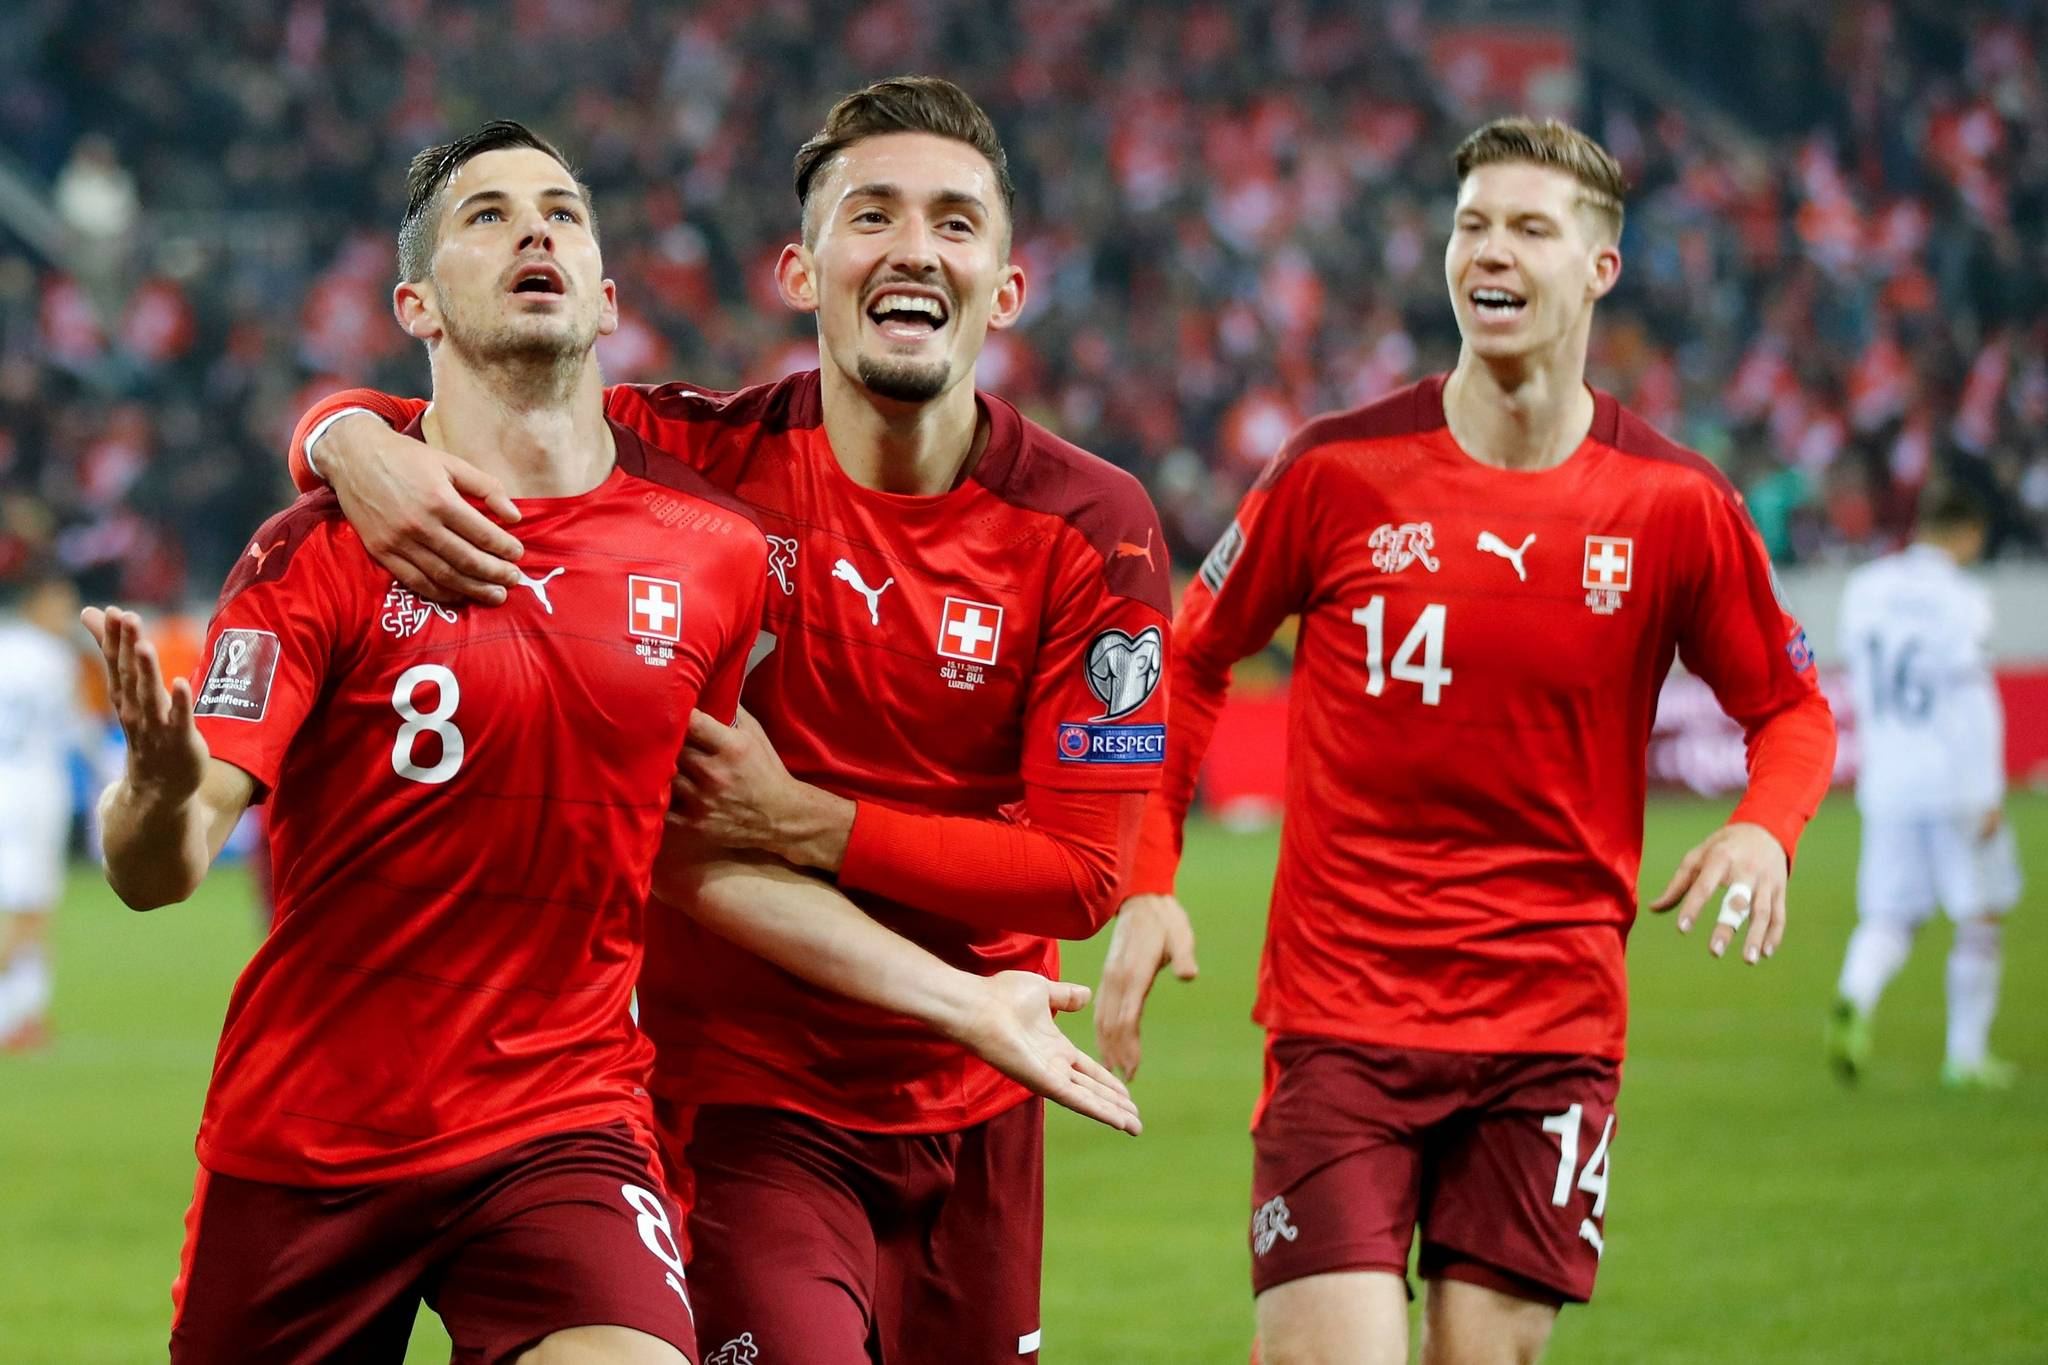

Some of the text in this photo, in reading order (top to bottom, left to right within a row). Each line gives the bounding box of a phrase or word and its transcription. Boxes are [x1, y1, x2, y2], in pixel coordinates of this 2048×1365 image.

[636, 644, 651, 656] SUI
[659, 647, 676, 659] BUL
[940, 667, 957, 679] SUI
[966, 672, 985, 684] BUL
[1352, 595, 1453, 706] 14
[200, 693, 250, 707] Qualifiers
[391, 664, 465, 784] 8
[1092, 735, 1165, 753] RESPECT
[1542, 1103, 1615, 1217] 14
[621, 1183, 686, 1280] 8
